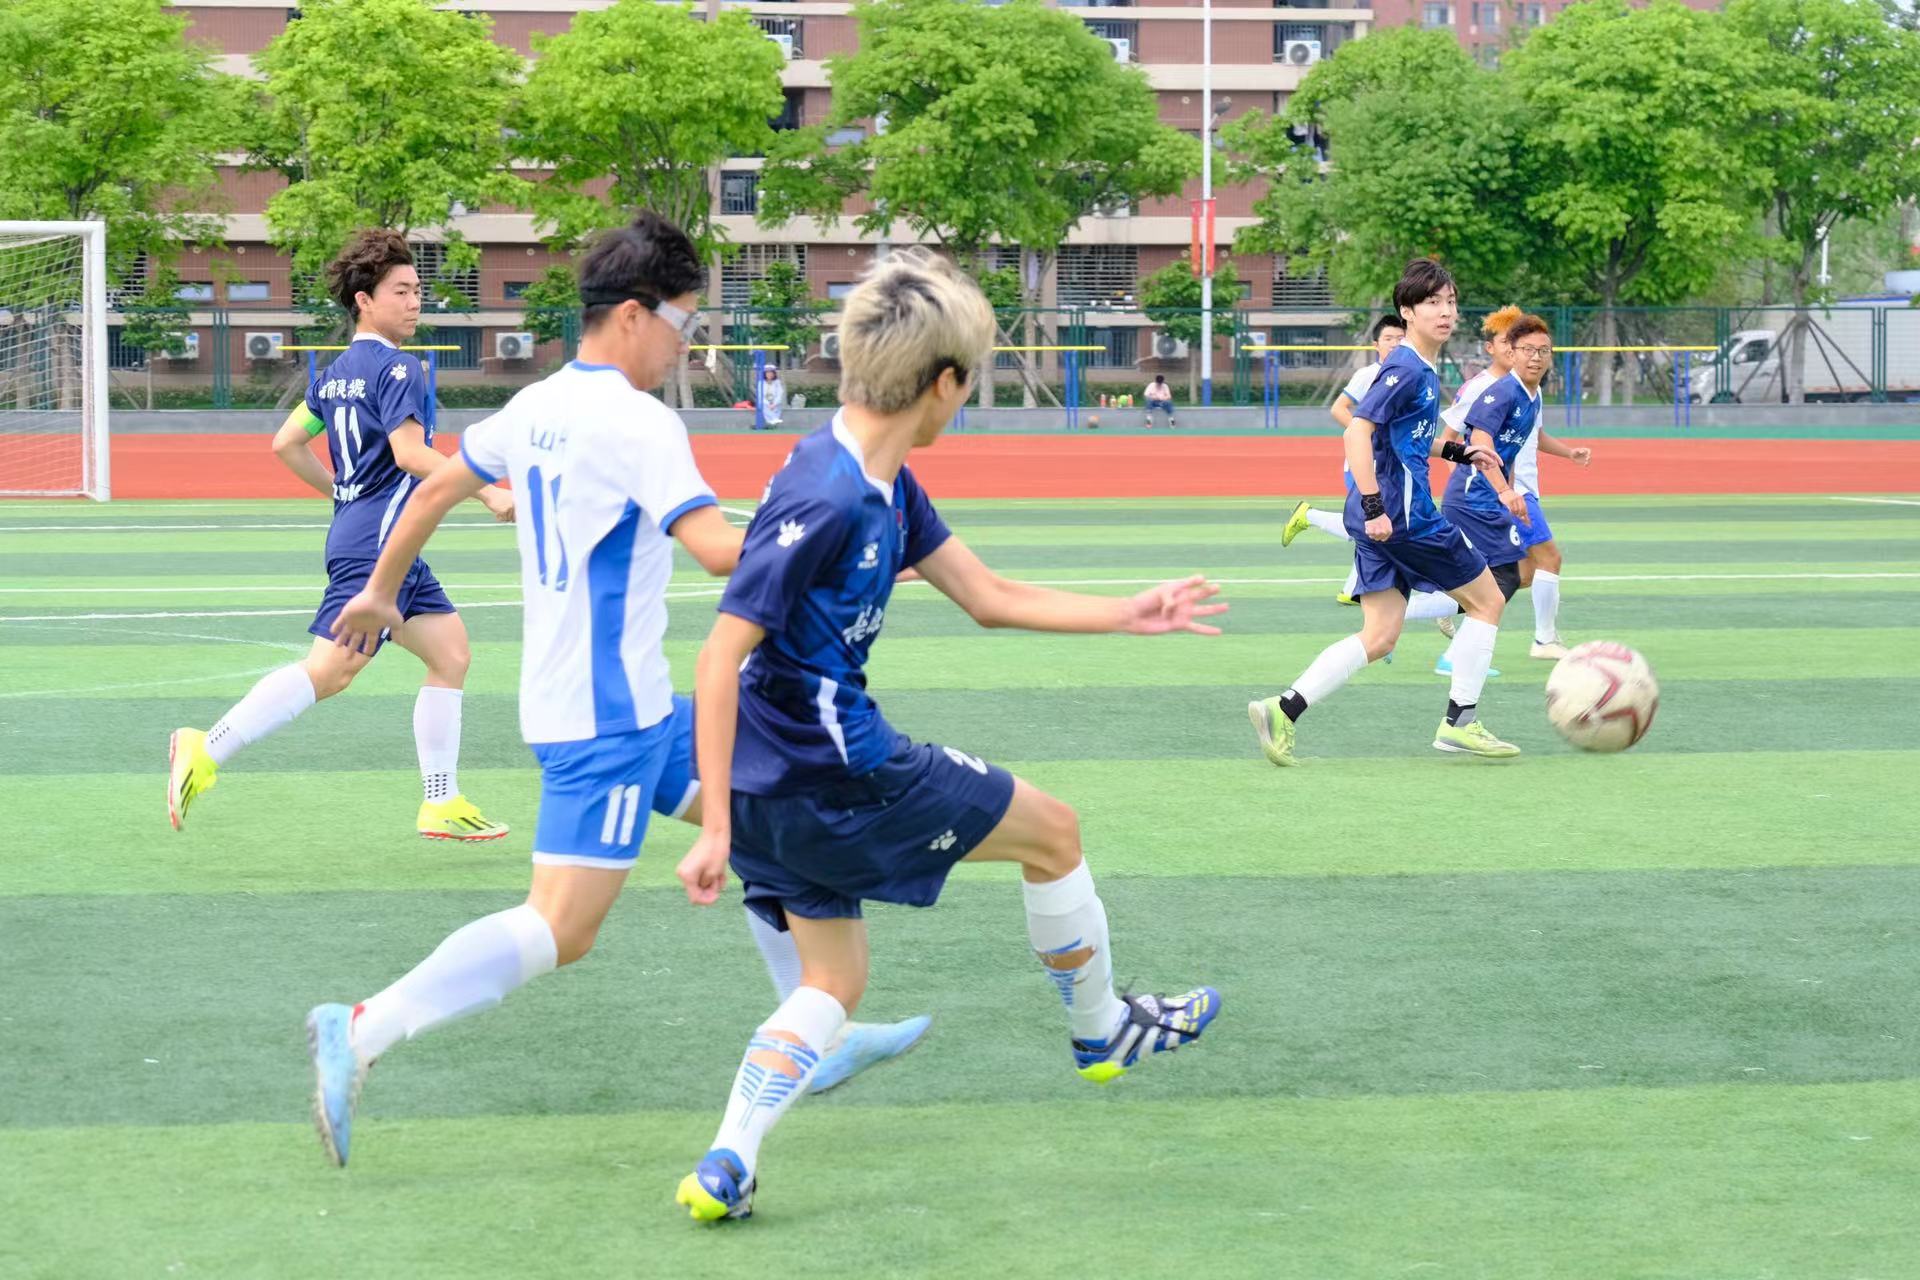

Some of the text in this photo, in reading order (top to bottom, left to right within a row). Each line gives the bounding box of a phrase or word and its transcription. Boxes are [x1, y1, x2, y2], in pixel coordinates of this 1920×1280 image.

[334, 406, 363, 481] 11
[1509, 524, 1521, 546] 6
[943, 746, 988, 775] 2
[600, 784, 641, 846] 11
